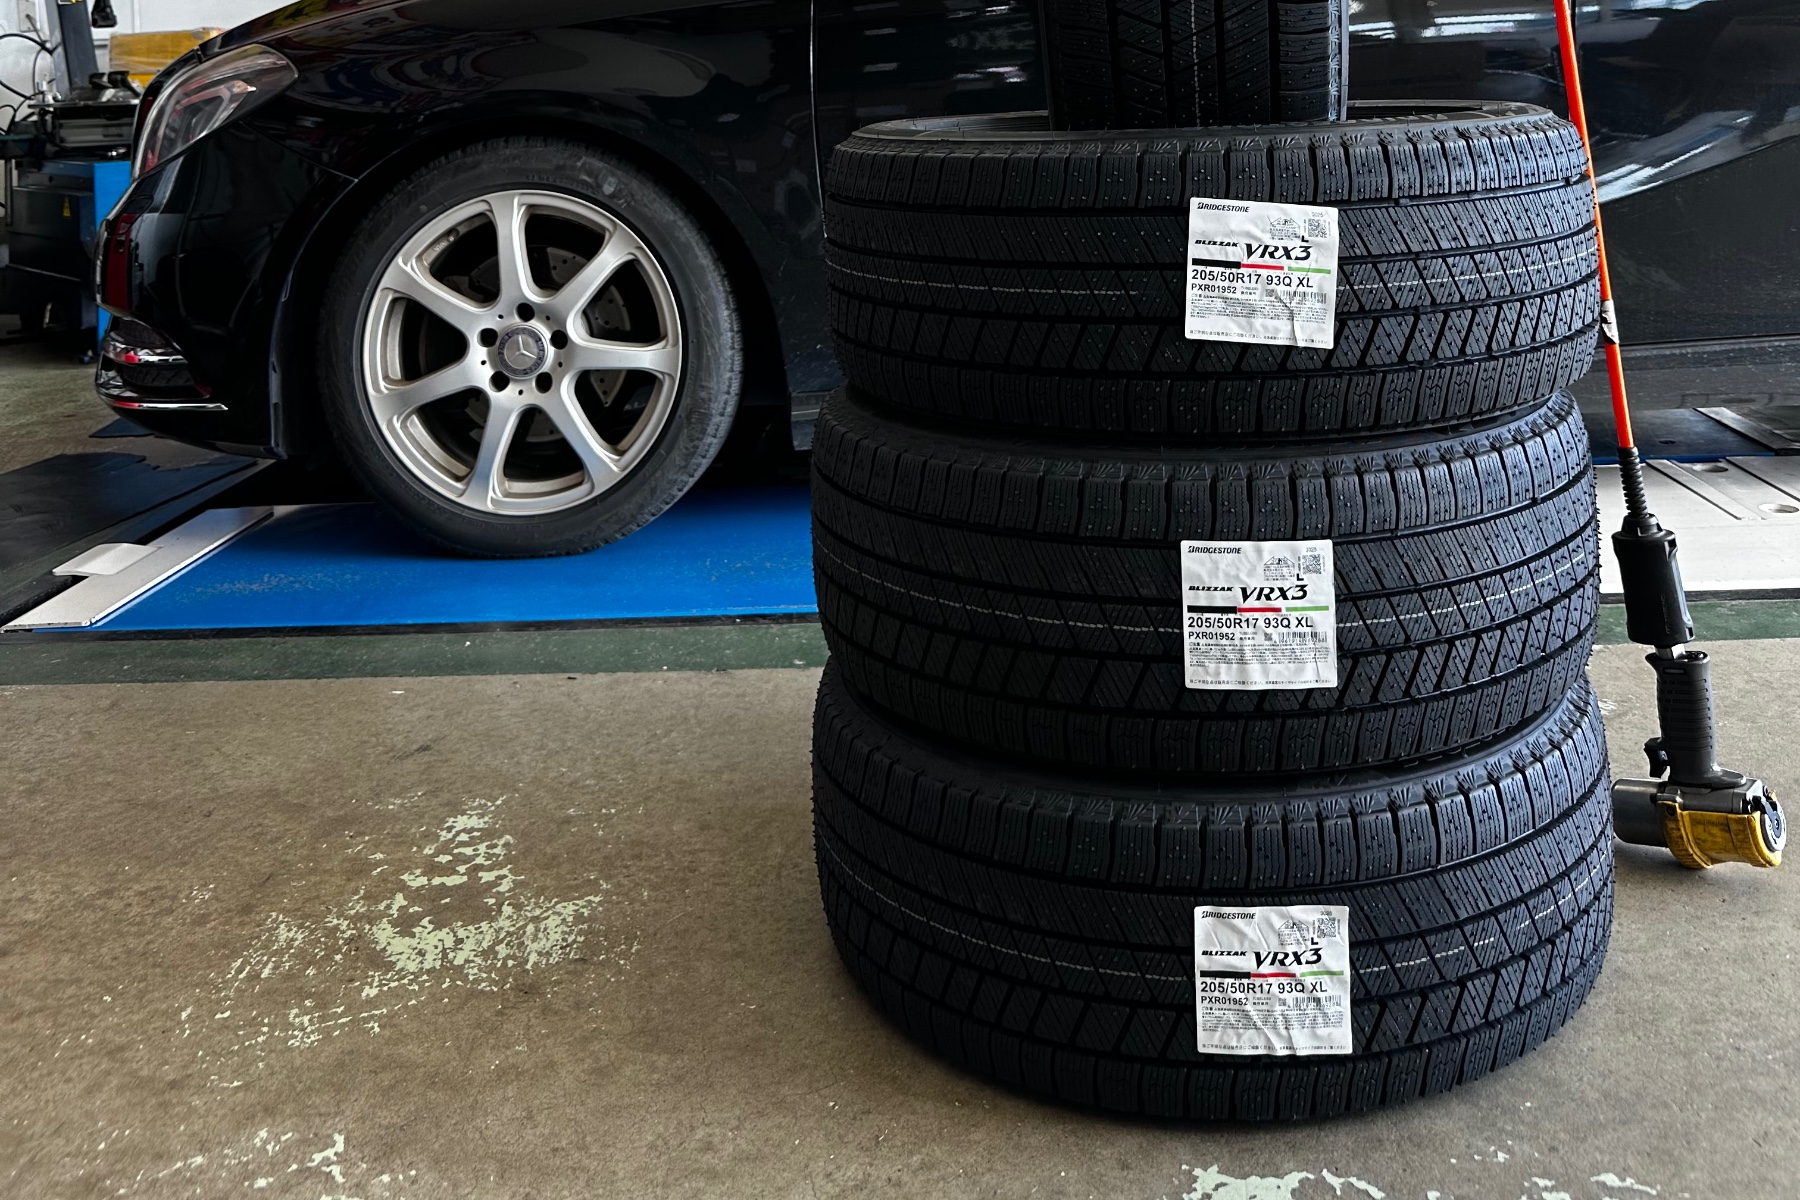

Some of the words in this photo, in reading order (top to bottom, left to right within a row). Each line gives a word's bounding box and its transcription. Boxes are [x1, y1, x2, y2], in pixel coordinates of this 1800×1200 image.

[1197, 201, 1250, 212] BRIDGESTONE
[1194, 239, 1239, 247] BLIZZAK
[1244, 243, 1313, 261] VRX3
[1191, 269, 1262, 285] 205/50R17
[1266, 274, 1292, 288] 93Q
[1296, 276, 1314, 288] XL
[1191, 283, 1237, 294] PXR01952
[1187, 545, 1243, 554] BRIDGESTONE
[1296, 573, 1304, 581] L
[1239, 584, 1309, 604] VRX3
[1187, 616, 1259, 629] 205/50R17
[1264, 617, 1291, 629] 93Q
[1295, 616, 1314, 628] XL
[1188, 631, 1236, 641] PXR01952
[1201, 911, 1256, 919] BRIDGESTONE
[1310, 937, 1319, 946] L
[1253, 947, 1323, 970] VRX3
[1200, 981, 1273, 994] 205/50R17
[1278, 982, 1305, 994] 93Q
[1310, 980, 1328, 993] XL
[1200, 996, 1249, 1006] PXR01952
